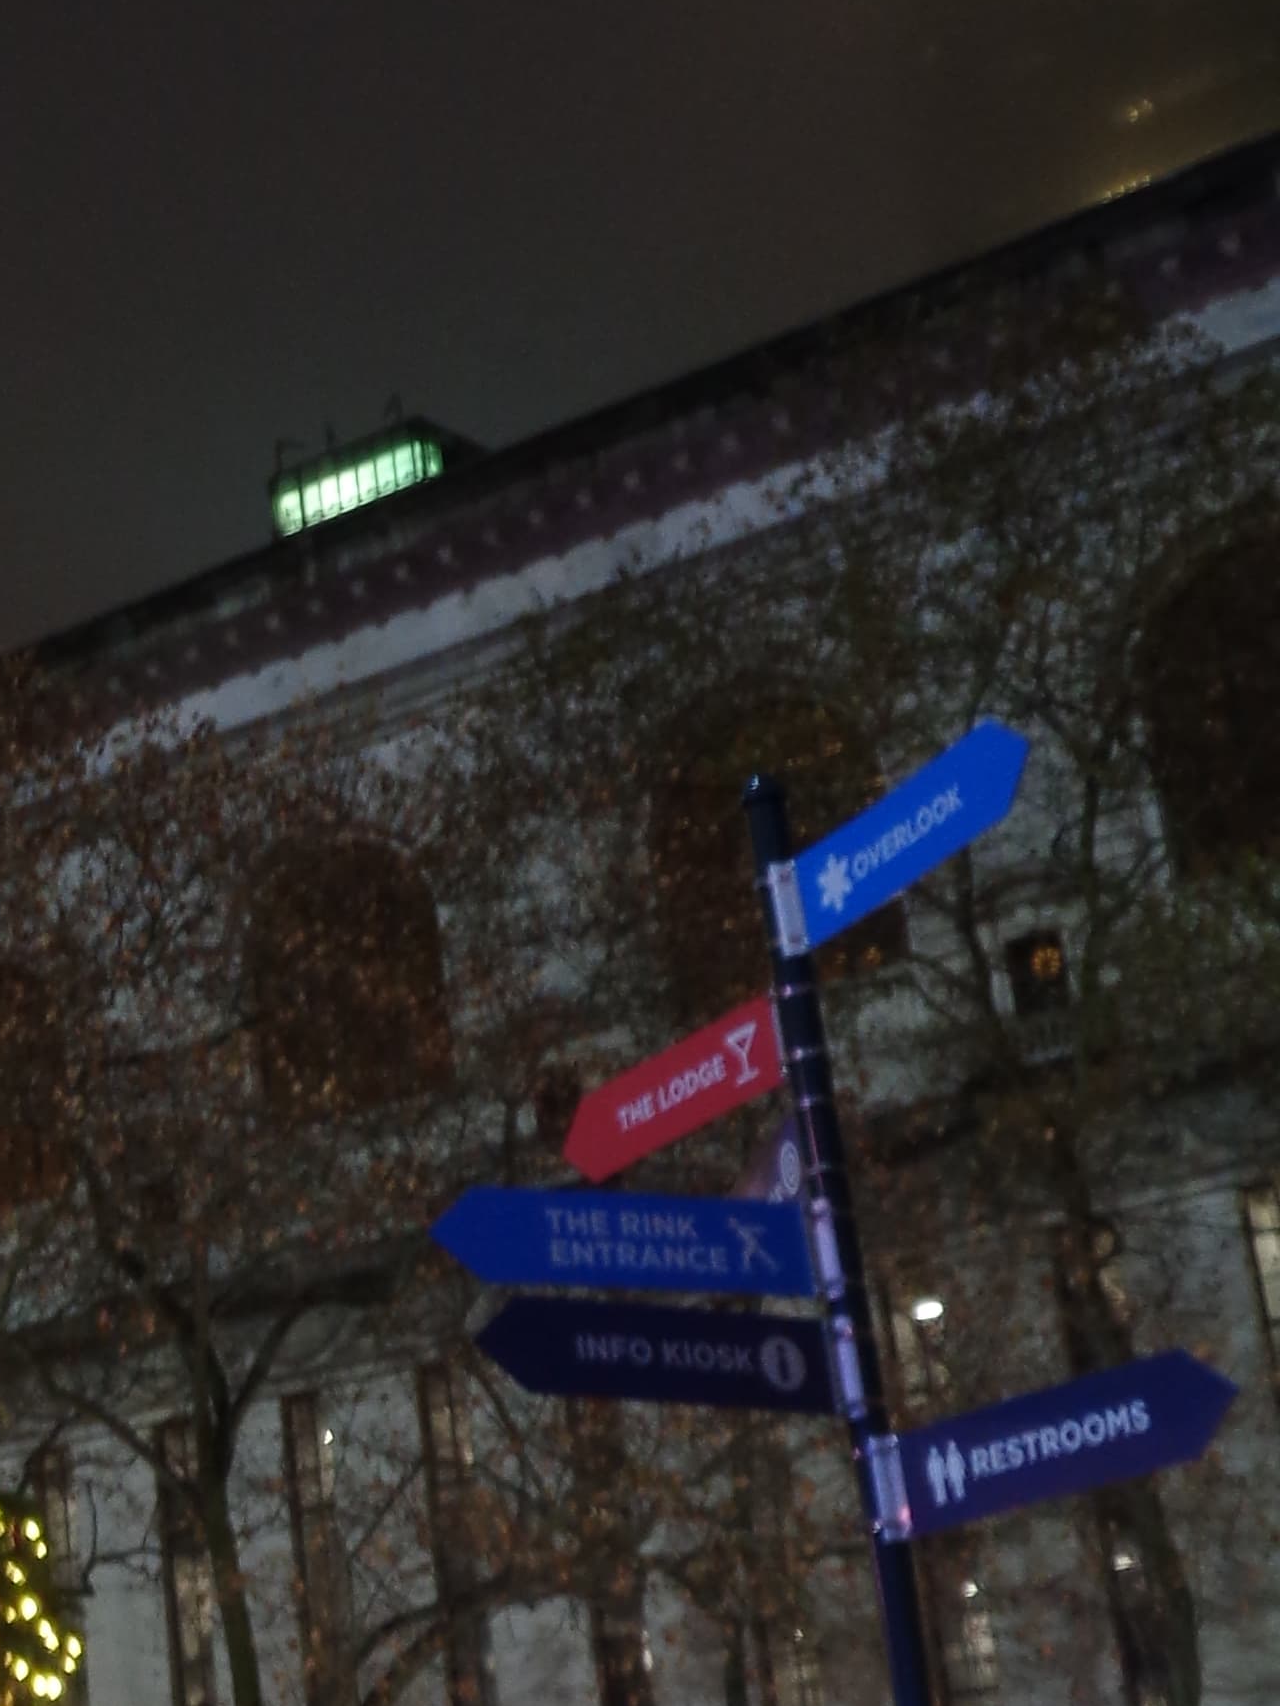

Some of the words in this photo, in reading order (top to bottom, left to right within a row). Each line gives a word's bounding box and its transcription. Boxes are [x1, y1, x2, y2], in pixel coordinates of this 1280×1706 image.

[851, 782, 963, 880] OVERLOOK
[616, 1091, 656, 1134] THE
[656, 1053, 728, 1113] LODGE
[545, 1207, 609, 1236] THE
[618, 1210, 699, 1240] RINK
[550, 1238, 729, 1275] ENTRANCE
[575, 1331, 654, 1366] INFO
[660, 1337, 755, 1373] KIOSK
[969, 1398, 1152, 1481] RESTROOMS
